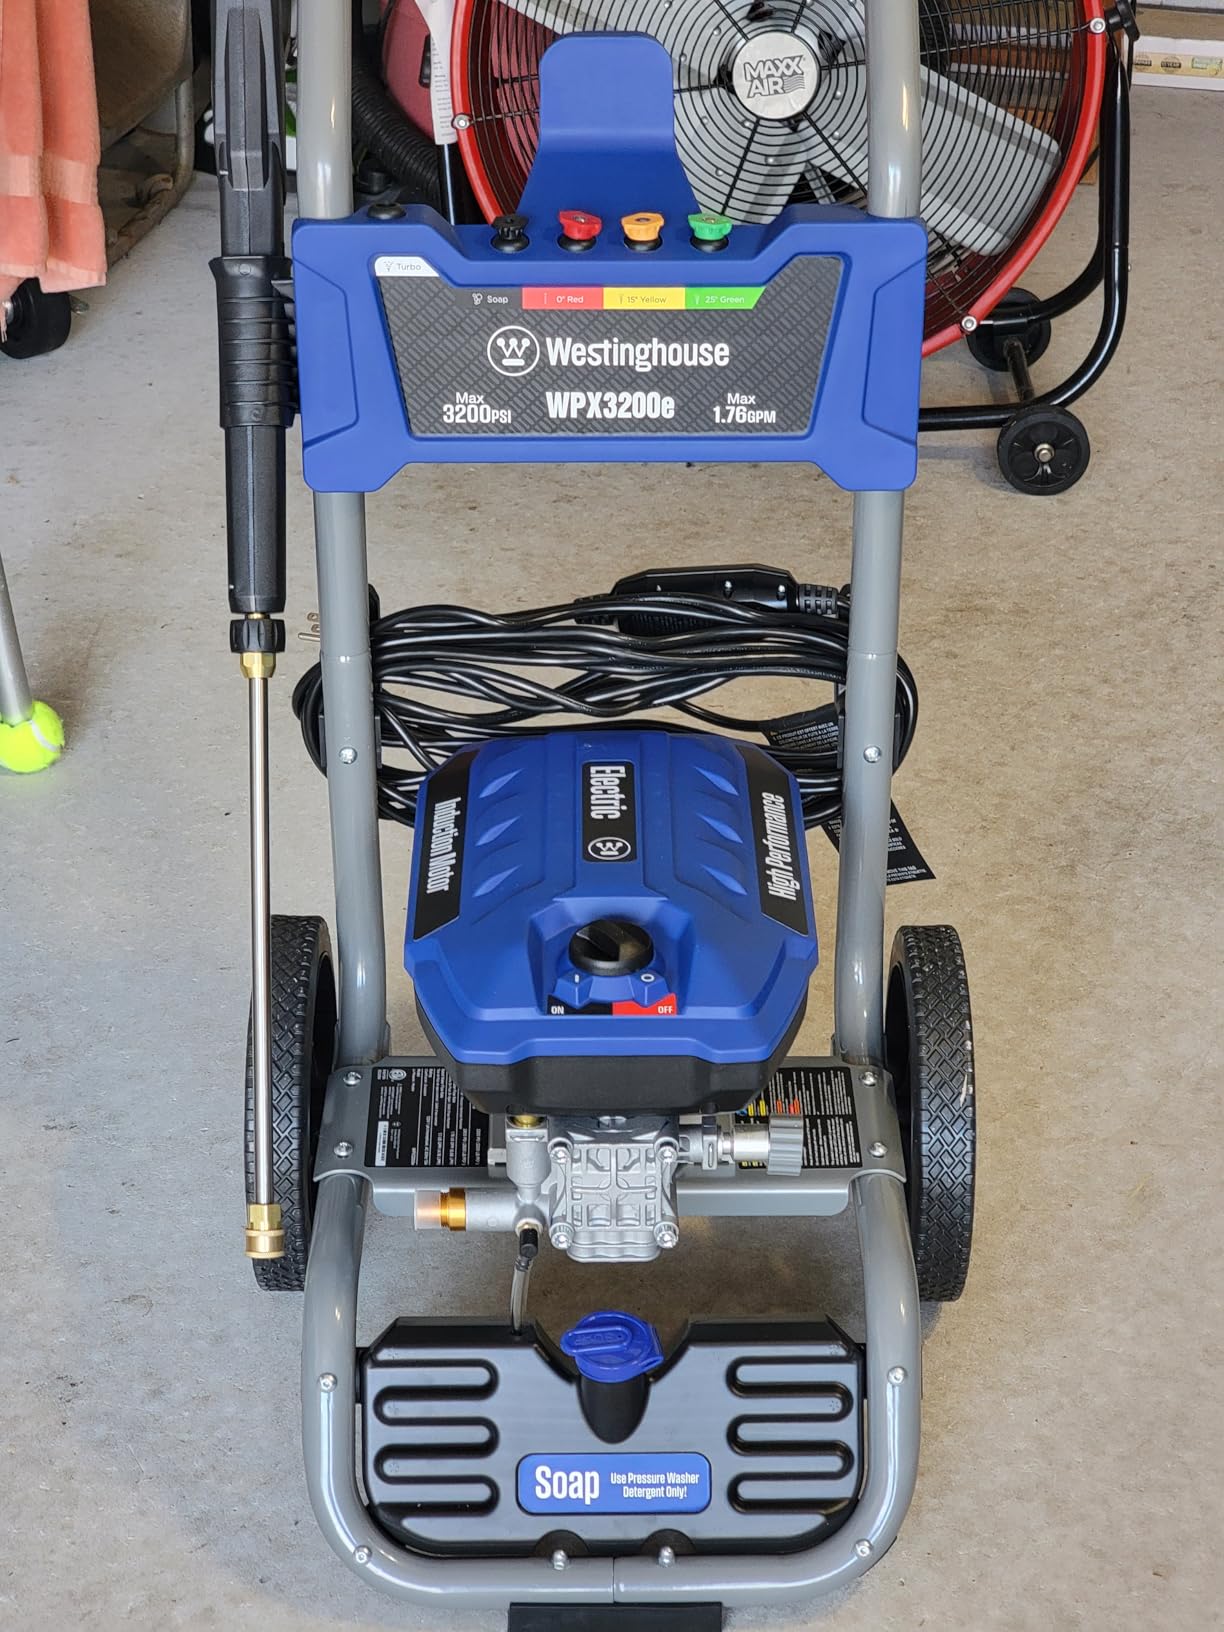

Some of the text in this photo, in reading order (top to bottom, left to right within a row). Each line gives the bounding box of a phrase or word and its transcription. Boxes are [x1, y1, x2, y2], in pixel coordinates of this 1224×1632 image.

[744, 55, 804, 81] MAXX
[747, 76, 785, 98] AIR
[396, 263, 422, 271] Turbo
[486, 295, 509, 304] Soap
[567, 295, 585, 304] Red
[640, 295, 667, 304] Yellow
[720, 295, 745, 304] Green
[546, 337, 730, 372] Westinghouse
[455, 391, 485, 404] Max
[727, 392, 757, 405] Max
[546, 391, 675, 420] WPX3200e
[442, 403, 512, 424] 3200PSI
[713, 405, 777, 424] 1.76GPM
[589, 766, 628, 820] Electric
[426, 797, 462, 894] Induction Motor
[761, 792, 801, 900] High Performance
[551, 1005, 565, 1015] ON
[657, 1005, 673, 1014] OFF
[535, 1465, 600, 1505] Soap
[610, 1472, 700, 1484] Use Pressure Washer
[623, 1486, 688, 1500] Detergent Only!
